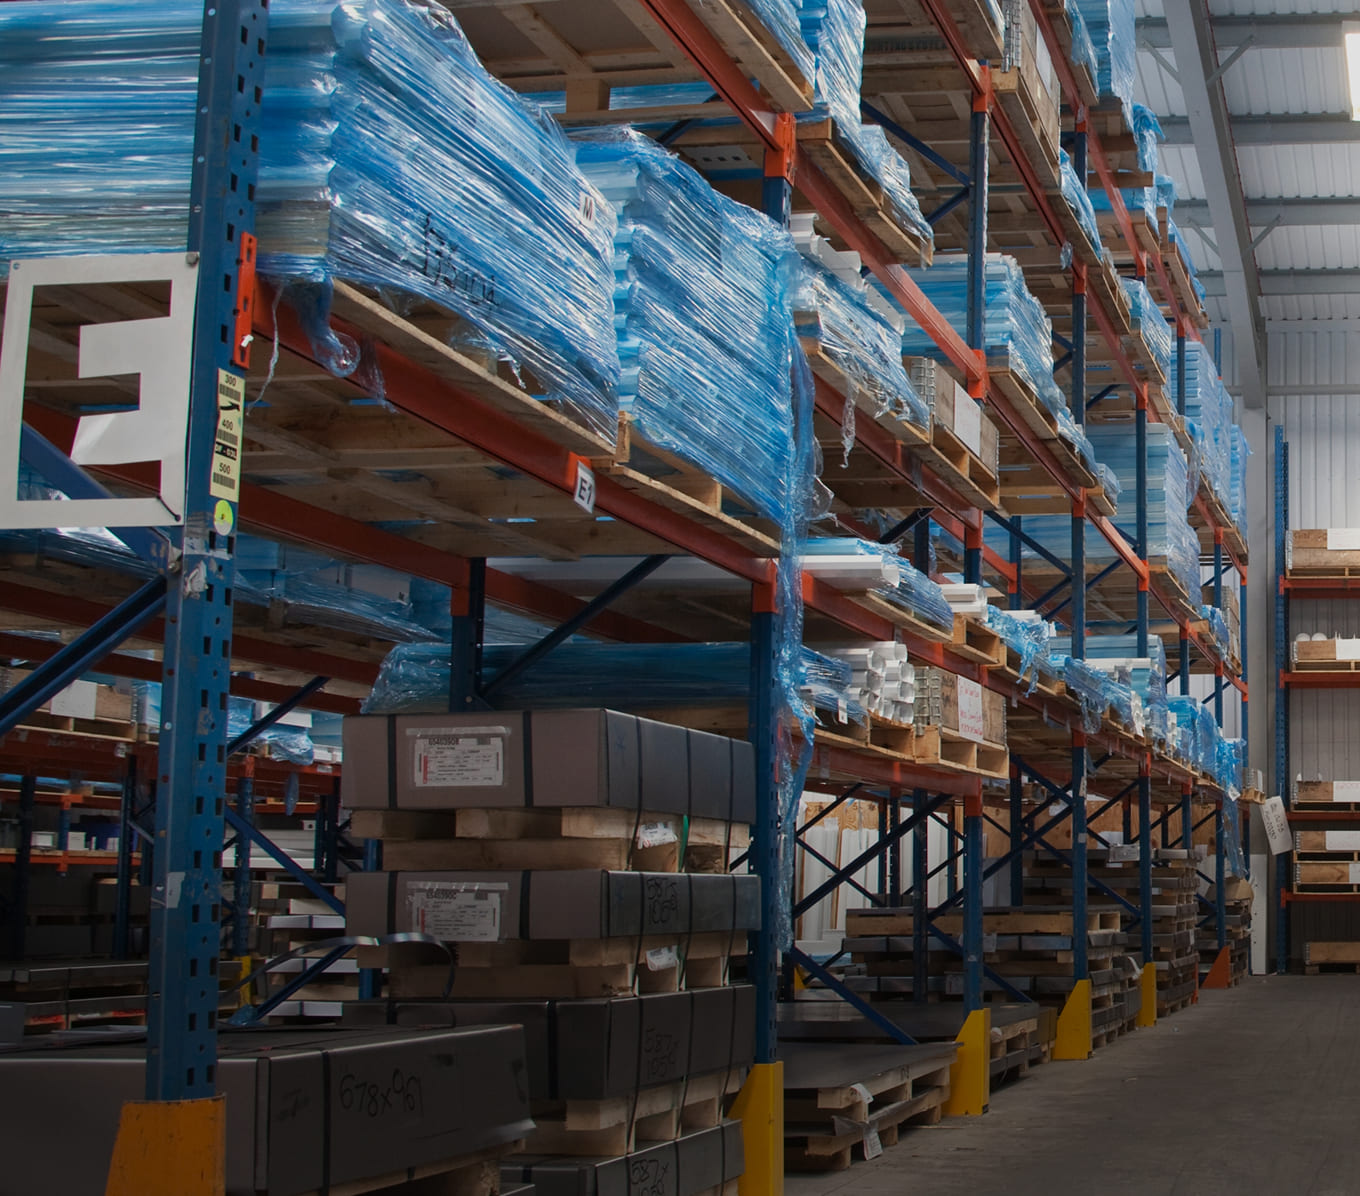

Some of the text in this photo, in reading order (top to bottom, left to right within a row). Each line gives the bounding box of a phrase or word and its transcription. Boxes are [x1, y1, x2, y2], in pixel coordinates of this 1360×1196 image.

[583, 197, 593, 221] M
[17, 279, 172, 501] E
[224, 374, 237, 387] 300
[221, 418, 234, 431] 400
[218, 462, 231, 475] 500
[578, 478, 593, 504] E1
[630, 1159, 670, 1185] 587x
